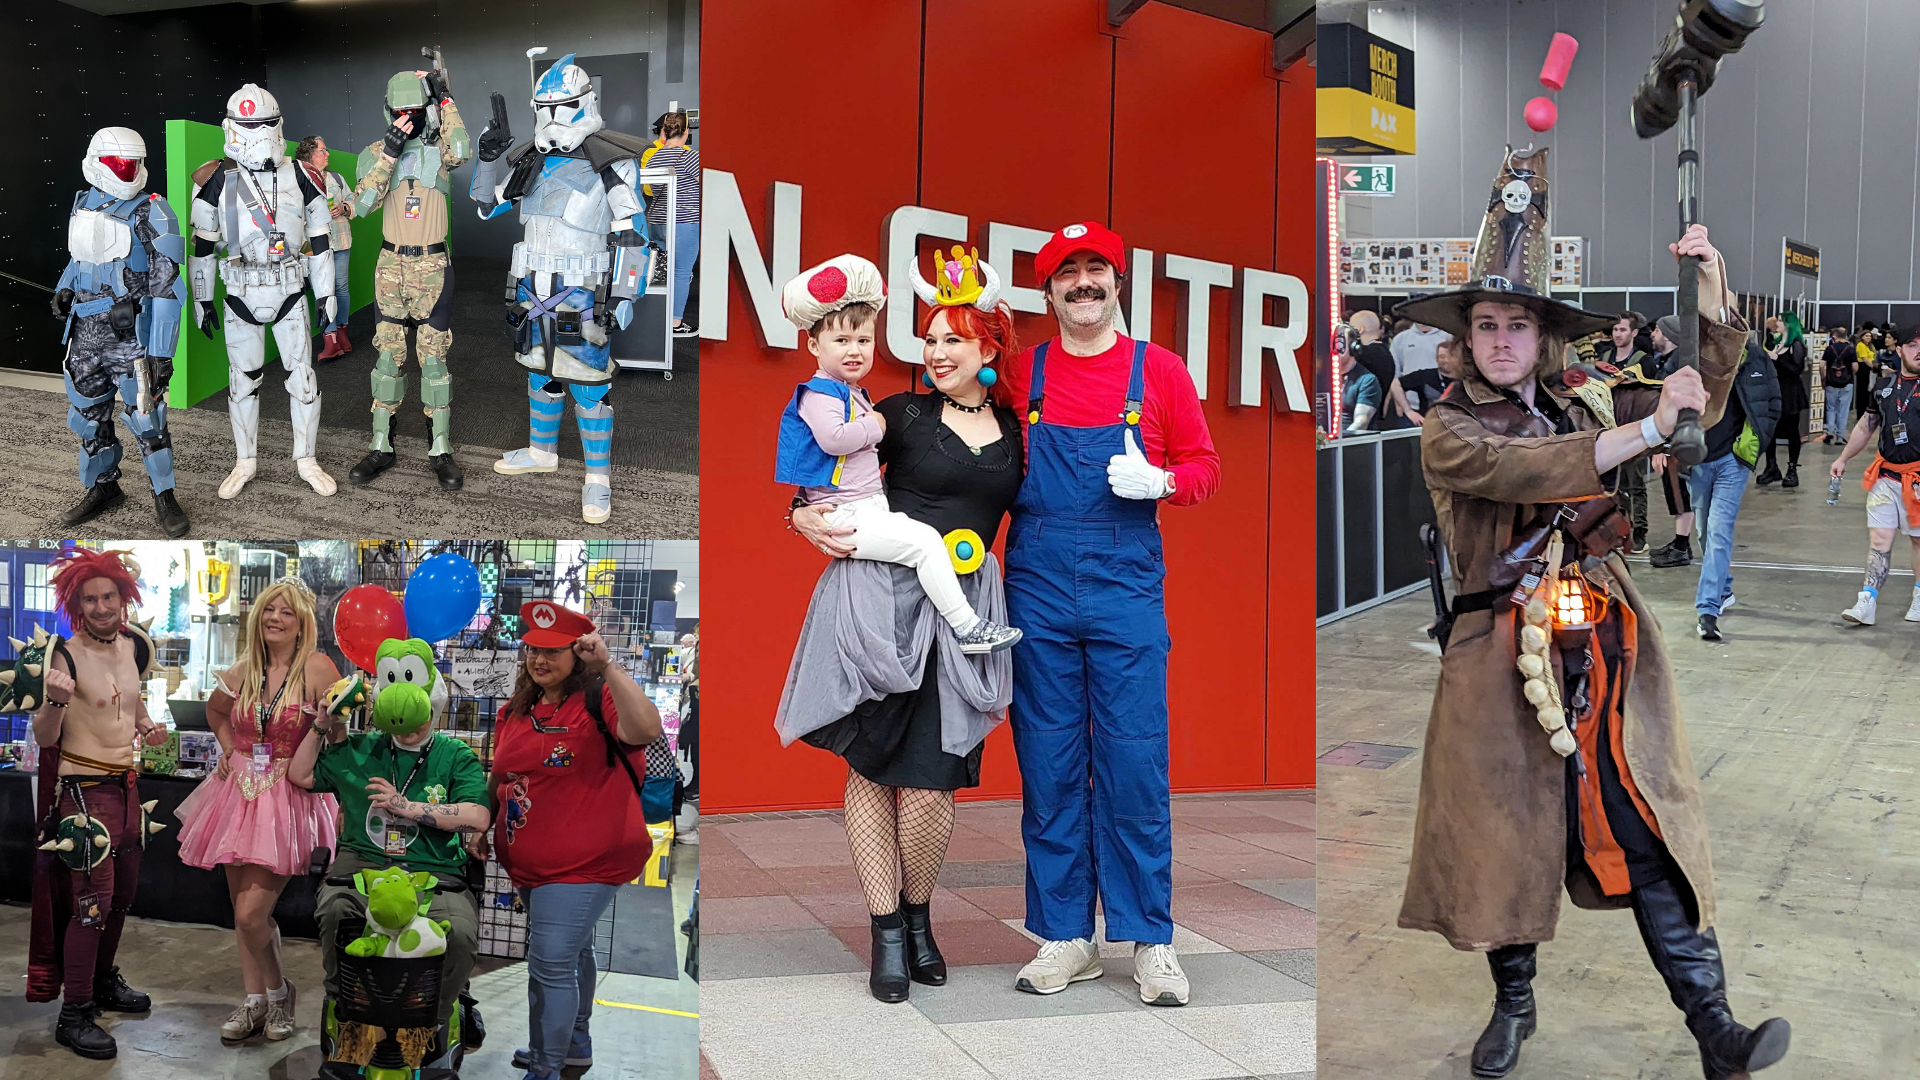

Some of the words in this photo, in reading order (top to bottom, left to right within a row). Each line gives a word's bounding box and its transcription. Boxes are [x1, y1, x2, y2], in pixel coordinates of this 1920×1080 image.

[1369, 43, 1397, 79] MERCH
[1371, 72, 1396, 104] BOOTH
[1371, 107, 1397, 133] PAX
[38, 540, 60, 549] BOX
[534, 607, 554, 622] M
